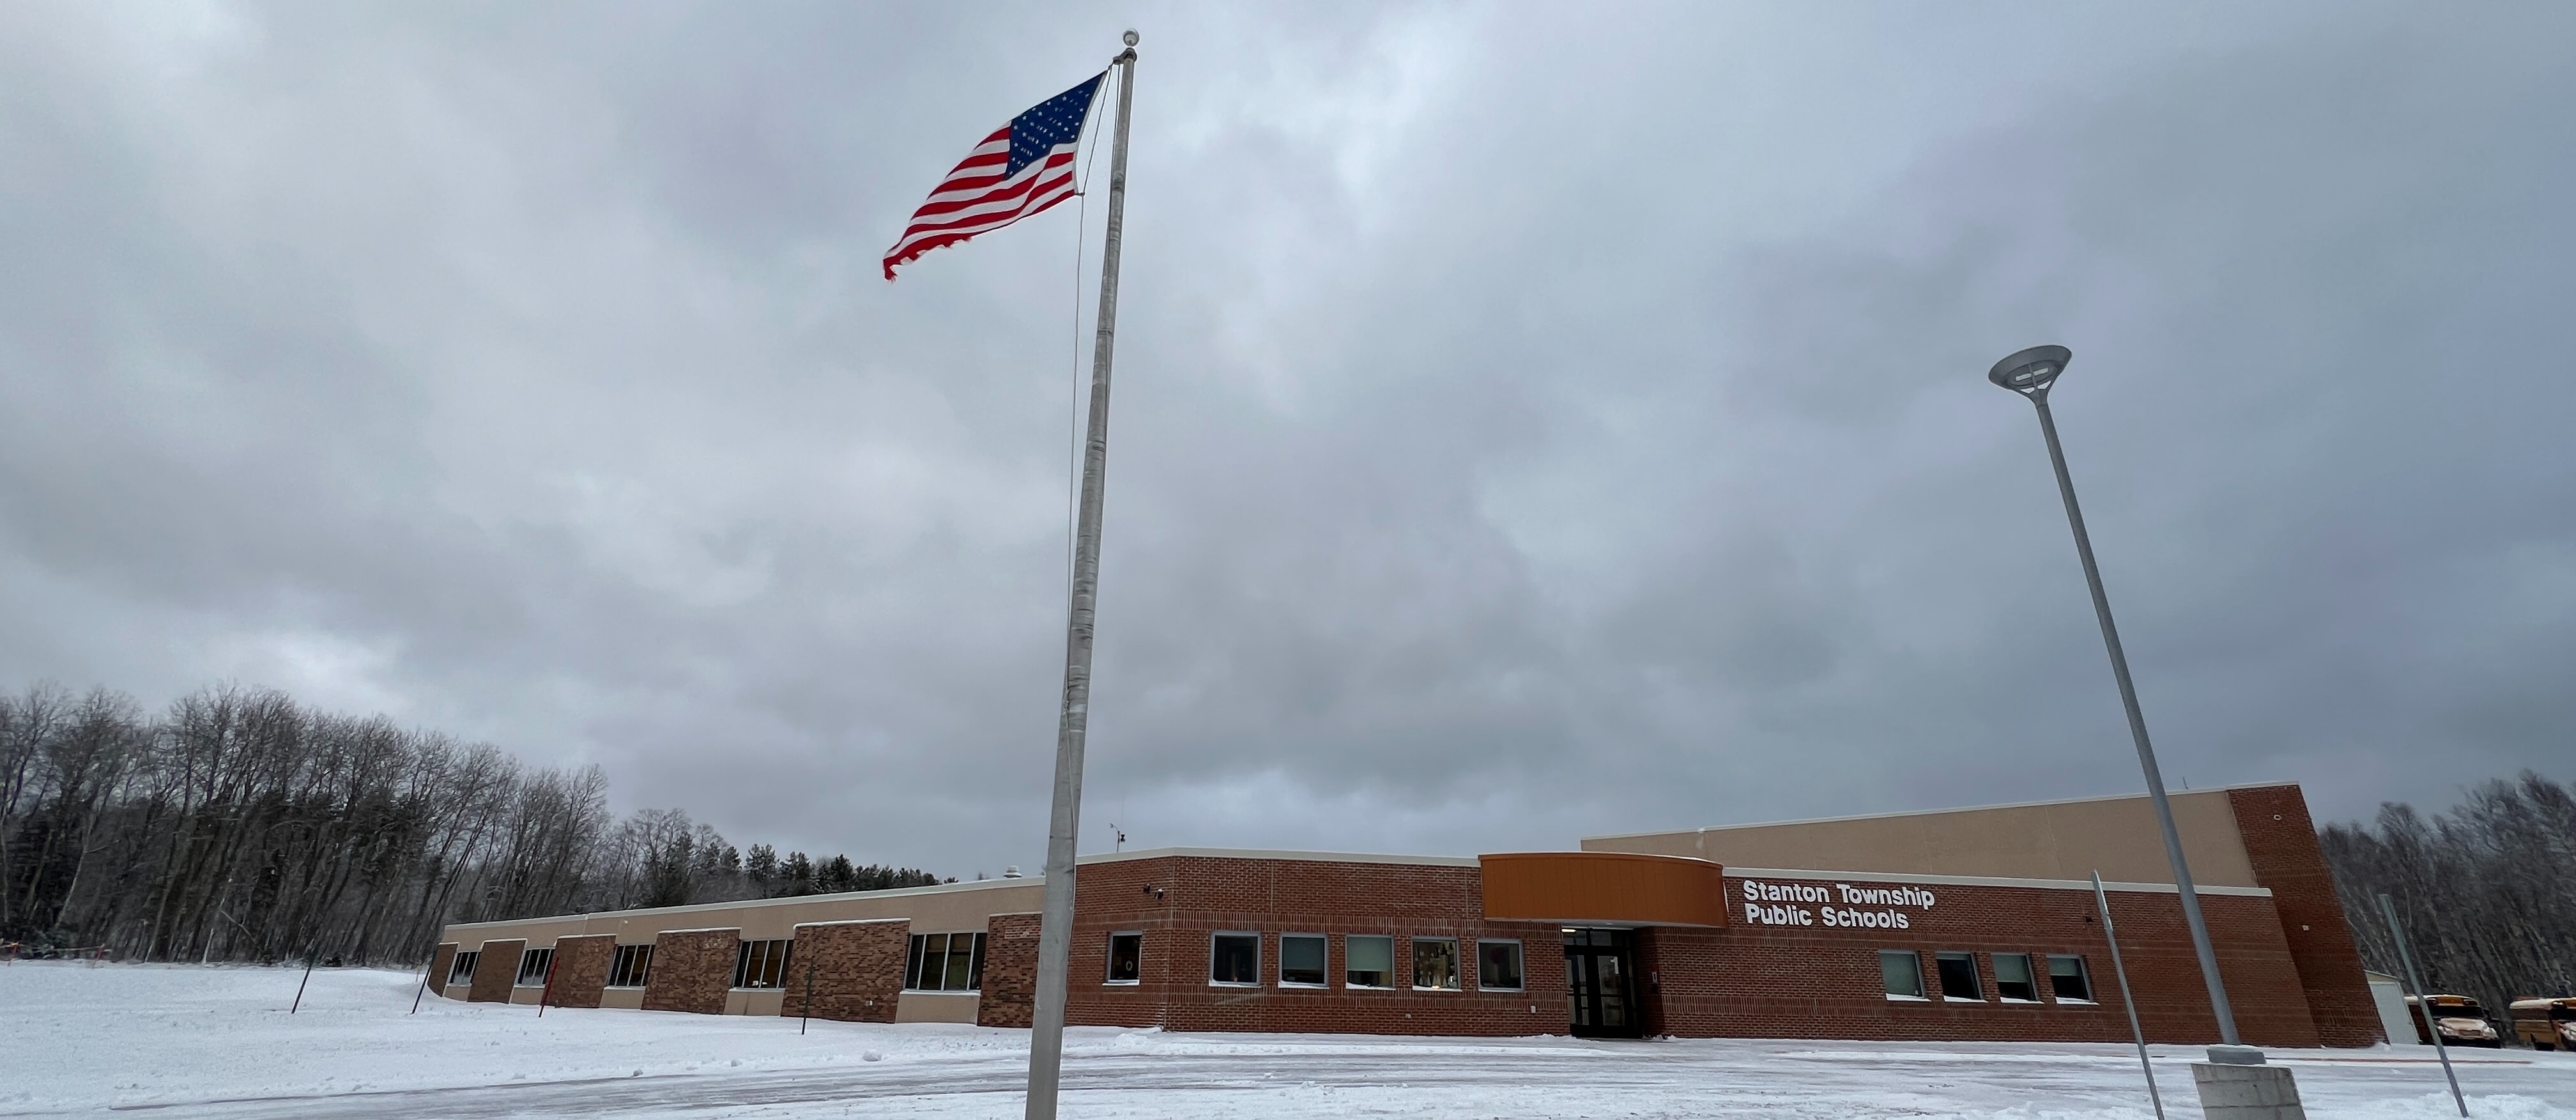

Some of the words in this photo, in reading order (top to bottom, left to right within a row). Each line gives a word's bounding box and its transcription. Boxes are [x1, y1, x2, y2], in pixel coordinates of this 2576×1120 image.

[1744, 880, 1829, 902] Stanton
[1836, 884, 1935, 910] Township
[1745, 903, 1813, 926] Public
[1821, 906, 1909, 929] Schools
[1610, 956, 1620, 974] 1
